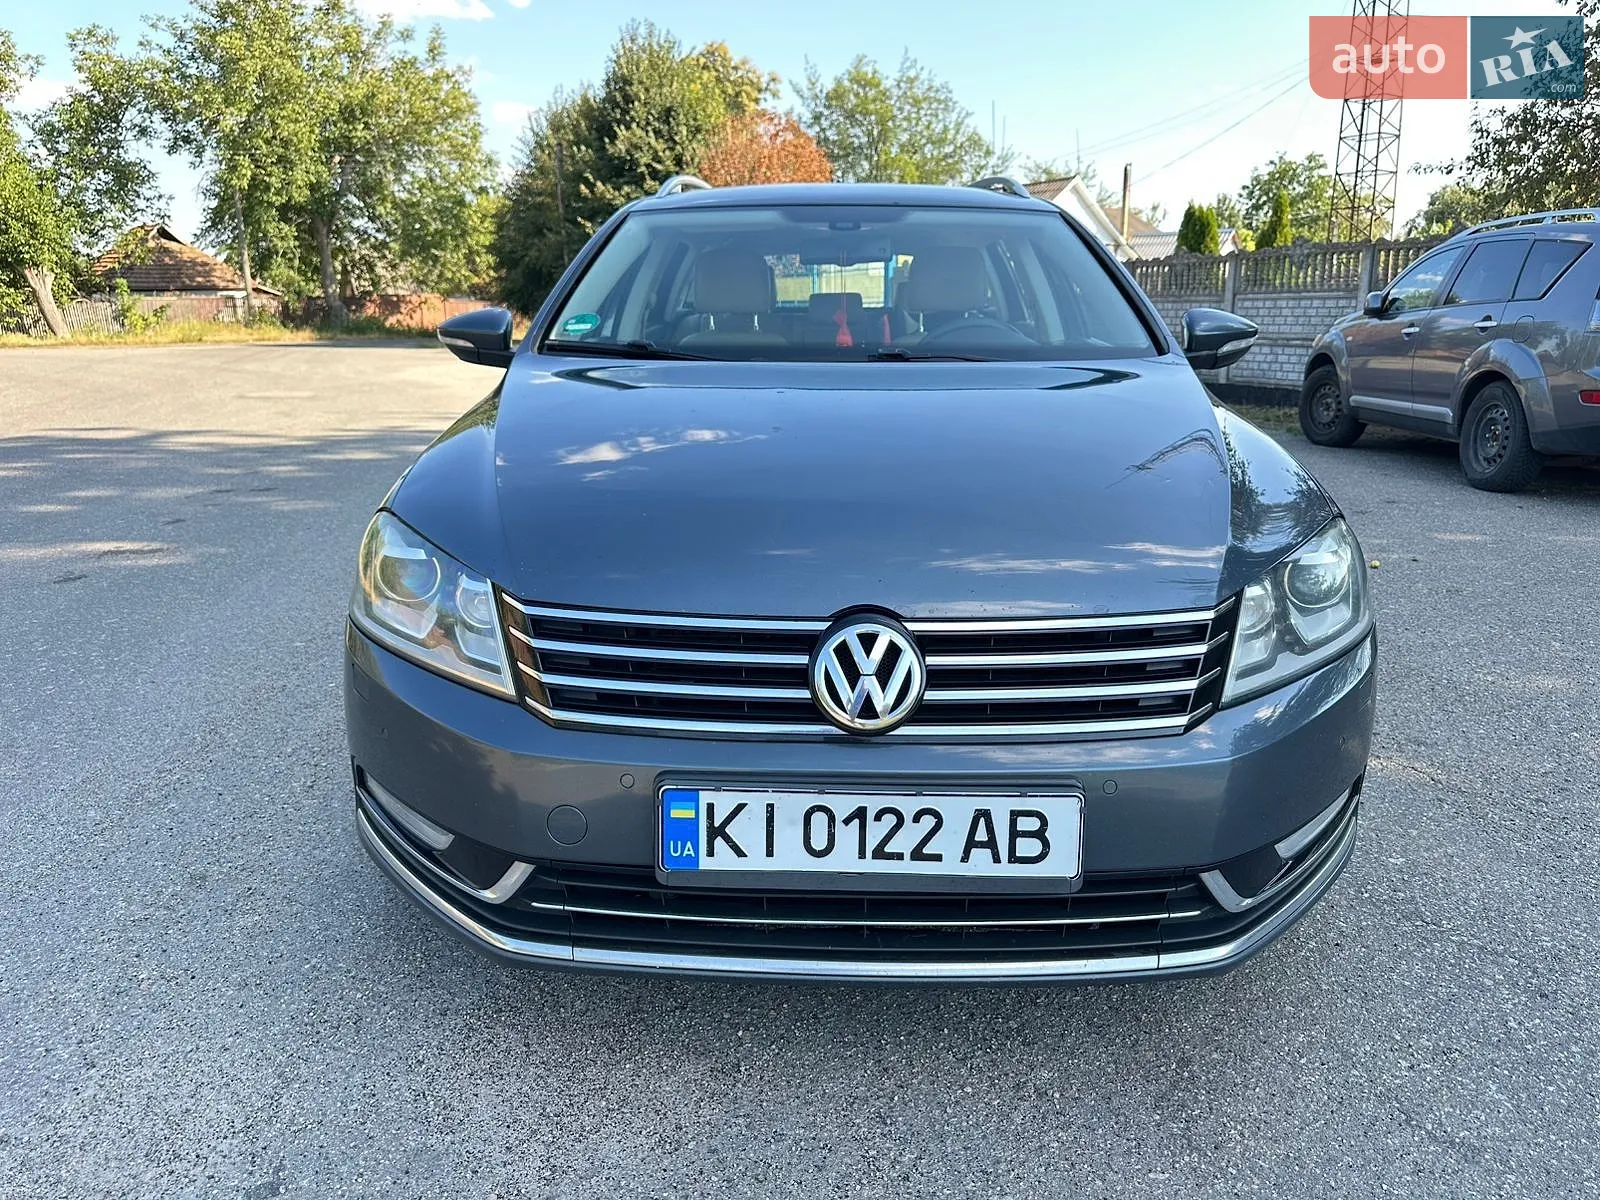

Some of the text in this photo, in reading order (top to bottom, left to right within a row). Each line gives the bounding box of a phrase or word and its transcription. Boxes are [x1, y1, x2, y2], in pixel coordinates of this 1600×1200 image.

[819, 626, 917, 724] VW
[669, 841, 696, 858] UA
[705, 802, 1051, 865] KI 0122 AB
